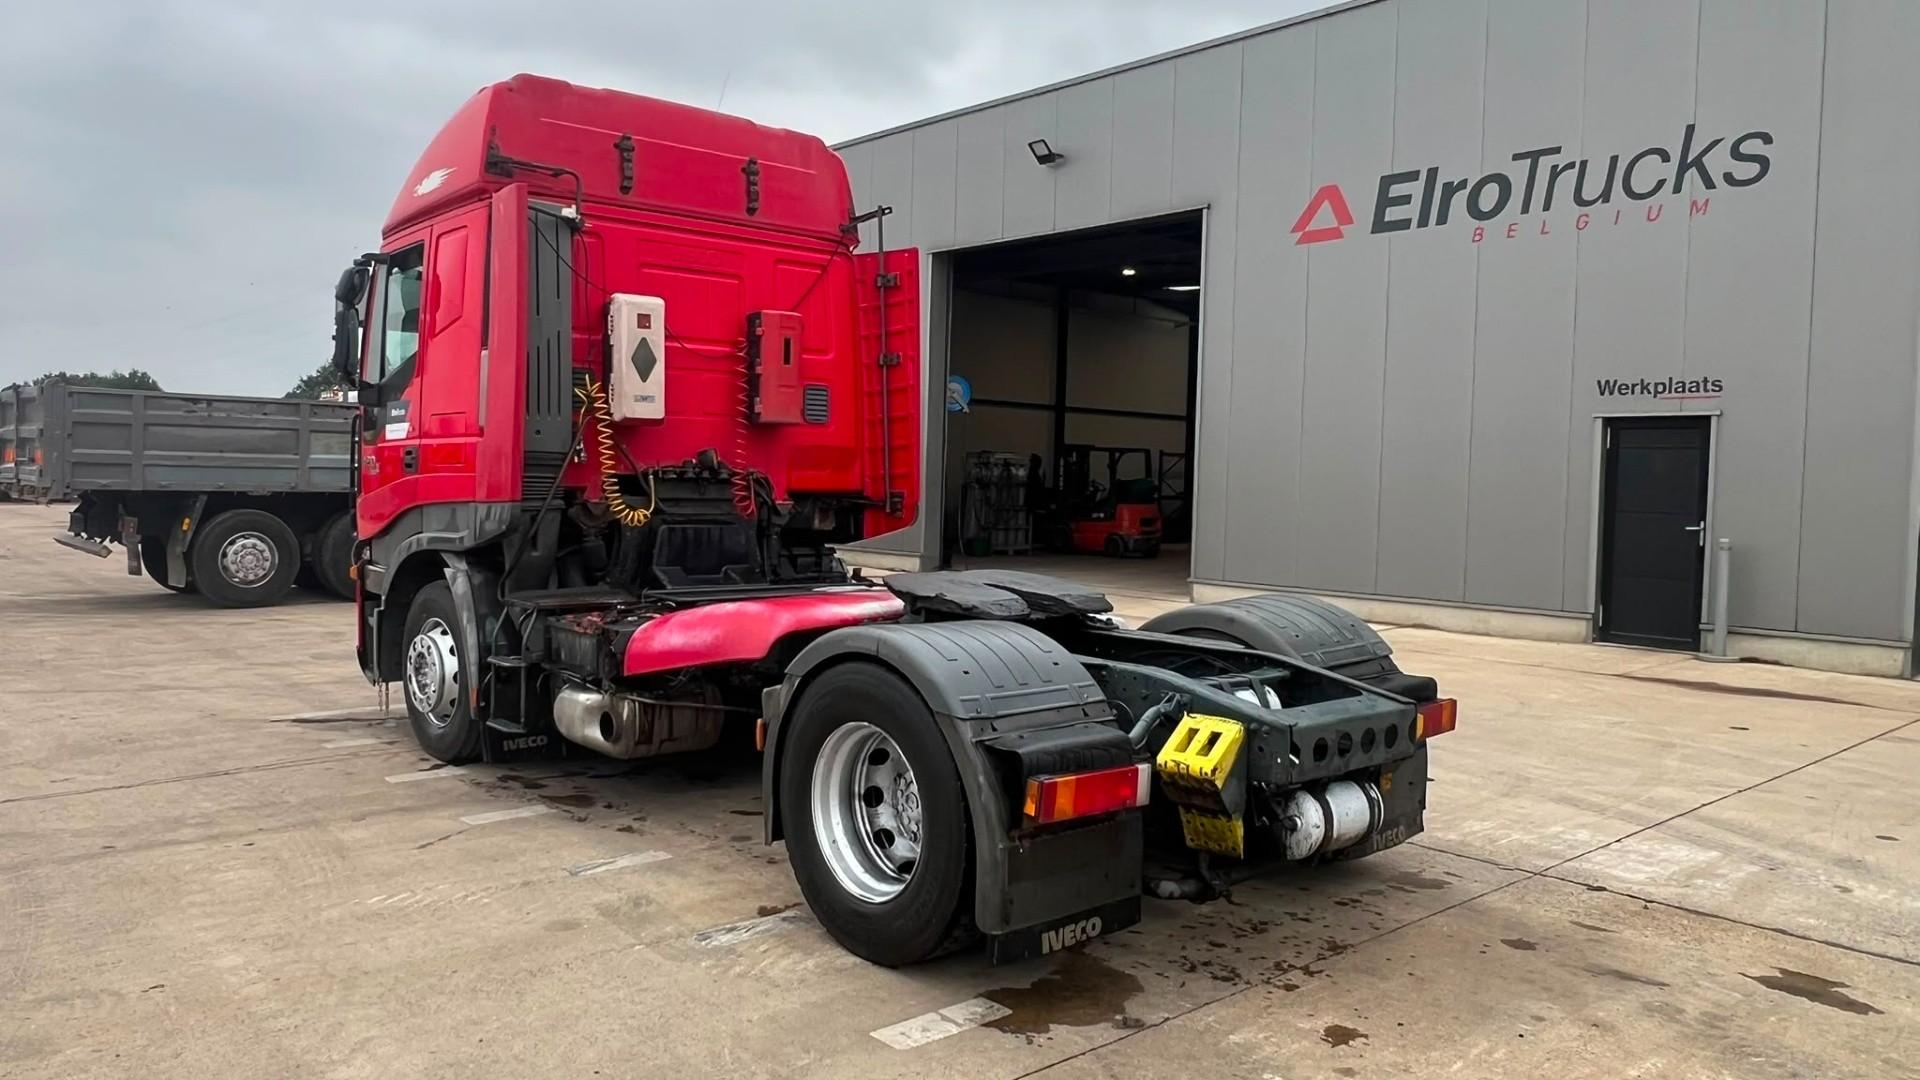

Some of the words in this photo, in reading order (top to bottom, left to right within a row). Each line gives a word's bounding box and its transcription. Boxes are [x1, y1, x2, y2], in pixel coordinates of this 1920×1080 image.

[1370, 123, 1774, 234] ElroTrucks
[1471, 198, 1711, 243] BELGIUM
[1597, 376, 1723, 398] Werkplaats
[503, 735, 548, 751] IVECO
[1373, 825, 1406, 850] IVECO
[1041, 916, 1102, 955] IVECO
